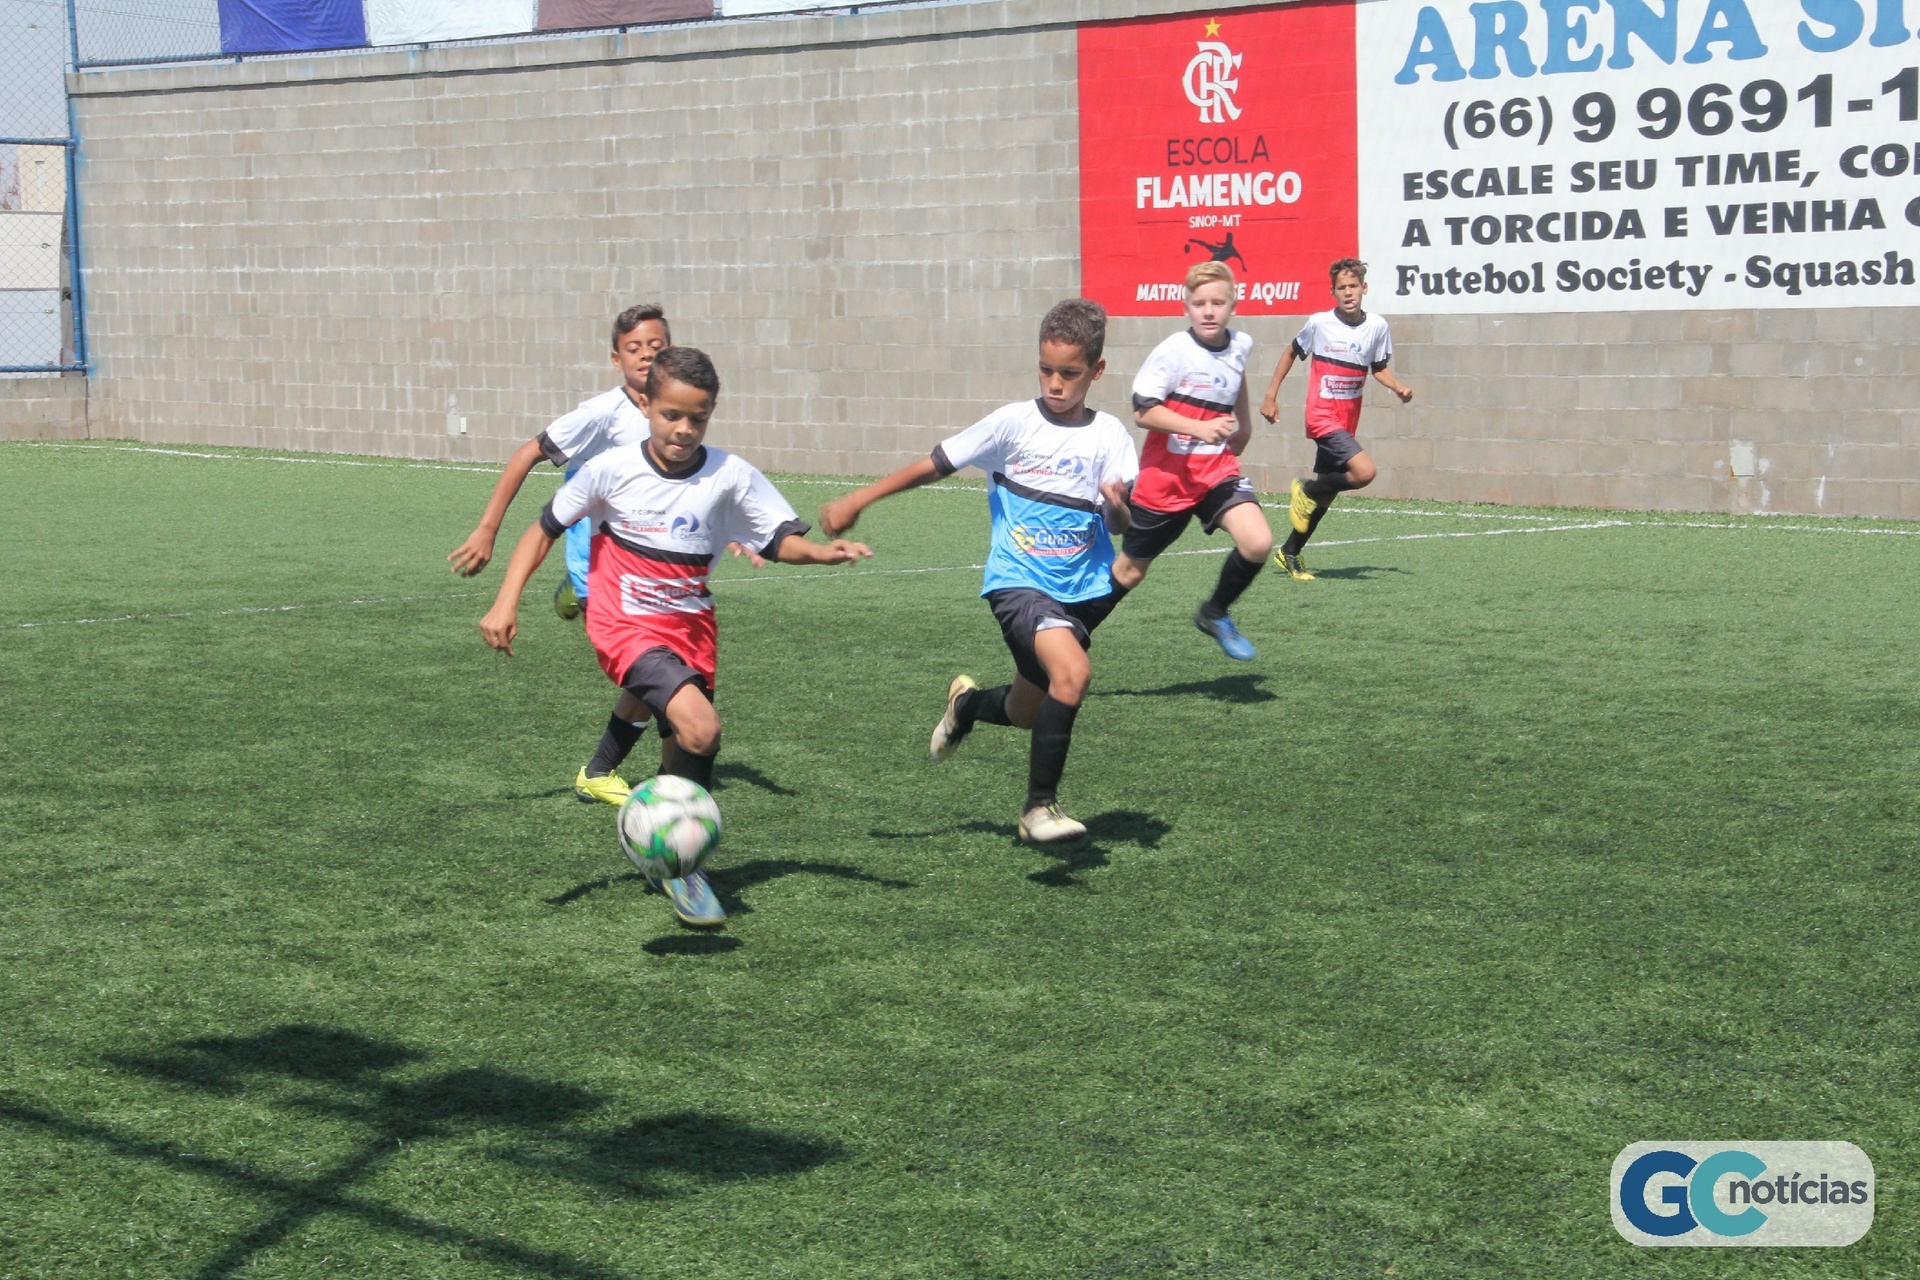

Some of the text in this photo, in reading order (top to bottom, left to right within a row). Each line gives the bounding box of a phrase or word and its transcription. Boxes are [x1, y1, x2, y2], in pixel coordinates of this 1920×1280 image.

[1394, 0, 1920, 84] ARENA SI
[1444, 67, 1919, 149] (66) 9 9691-1
[1167, 135, 1270, 167] ESCOLA
[1136, 170, 1302, 209] FLAMENGO
[1403, 142, 1920, 201] ESCALE SEU TIME, CO
[1188, 214, 1242, 229] SINOP-MT
[1401, 218, 1431, 247] A
[1444, 208, 1647, 246] TORCIDA
[1664, 206, 1688, 238] E
[1706, 197, 1886, 235] VENHA
[1249, 281, 1301, 306] AQUI!
[1395, 261, 1546, 296] Futebol
[1556, 258, 1713, 297] Society
